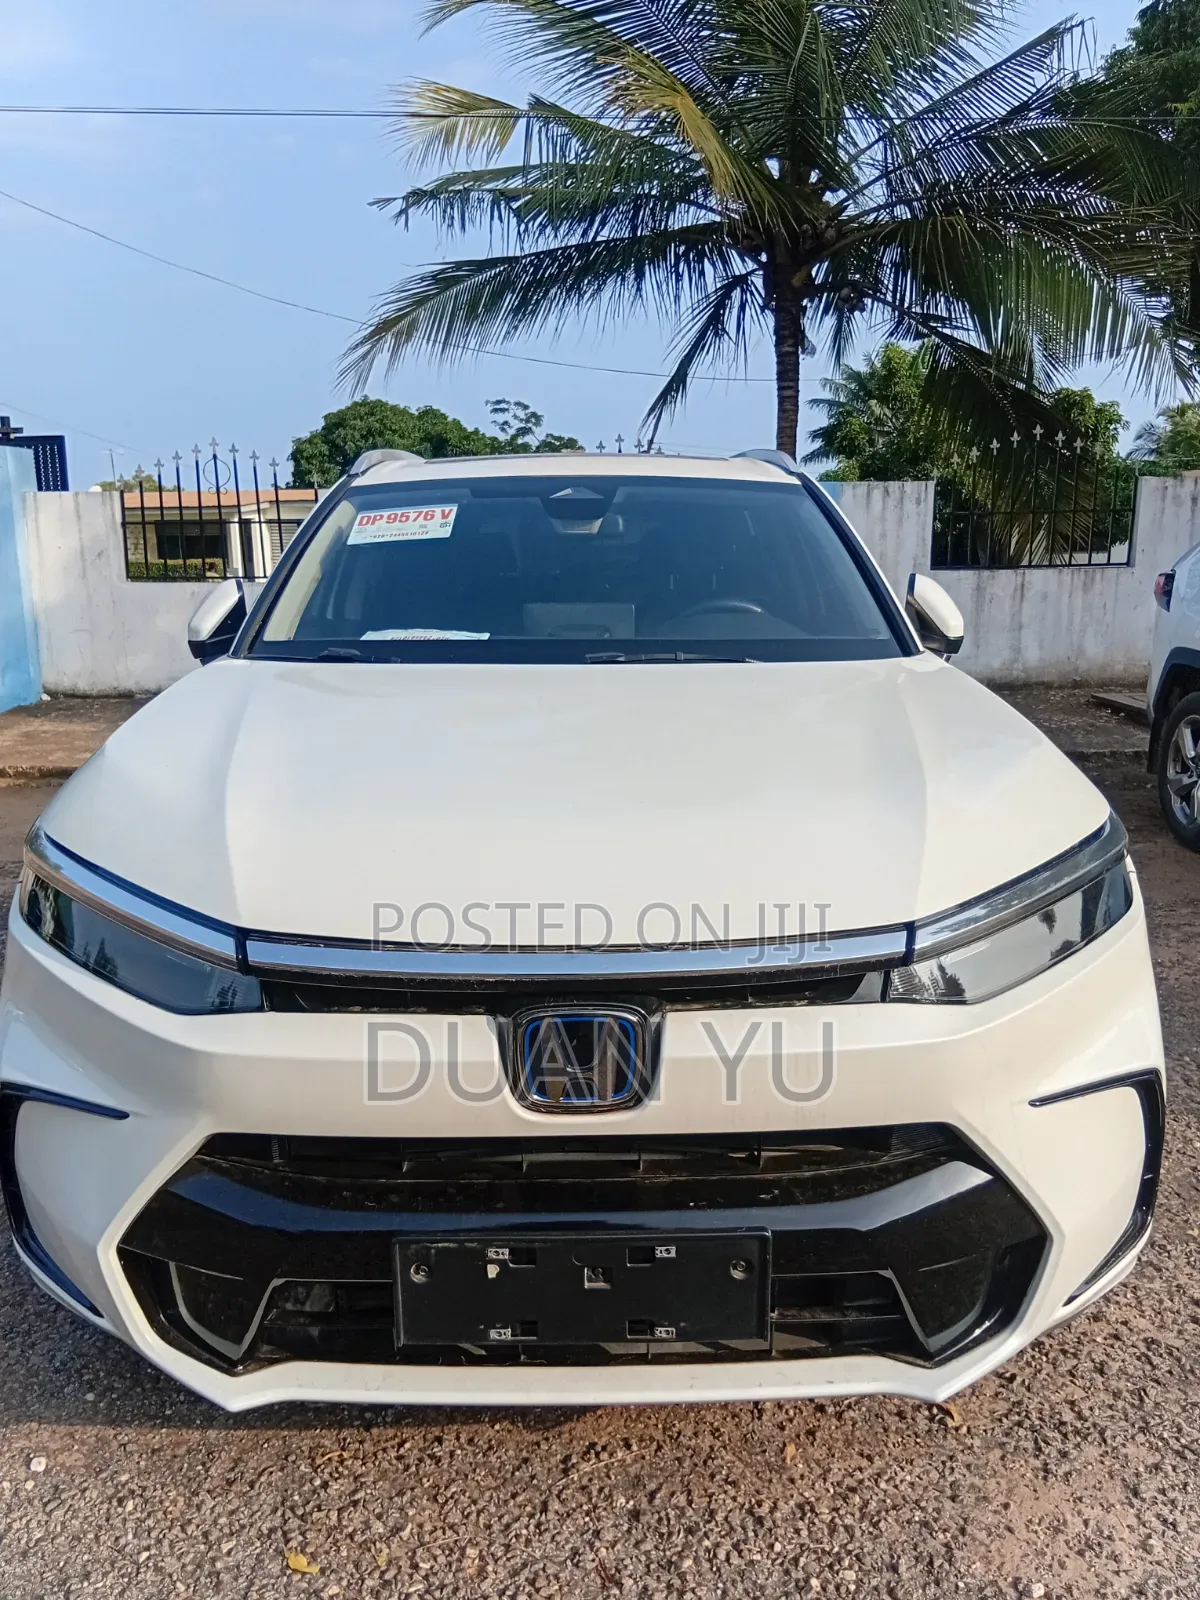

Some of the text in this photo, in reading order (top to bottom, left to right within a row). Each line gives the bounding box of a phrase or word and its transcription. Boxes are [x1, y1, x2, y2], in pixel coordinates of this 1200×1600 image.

[357, 508, 454, 527] DP 9576 V
